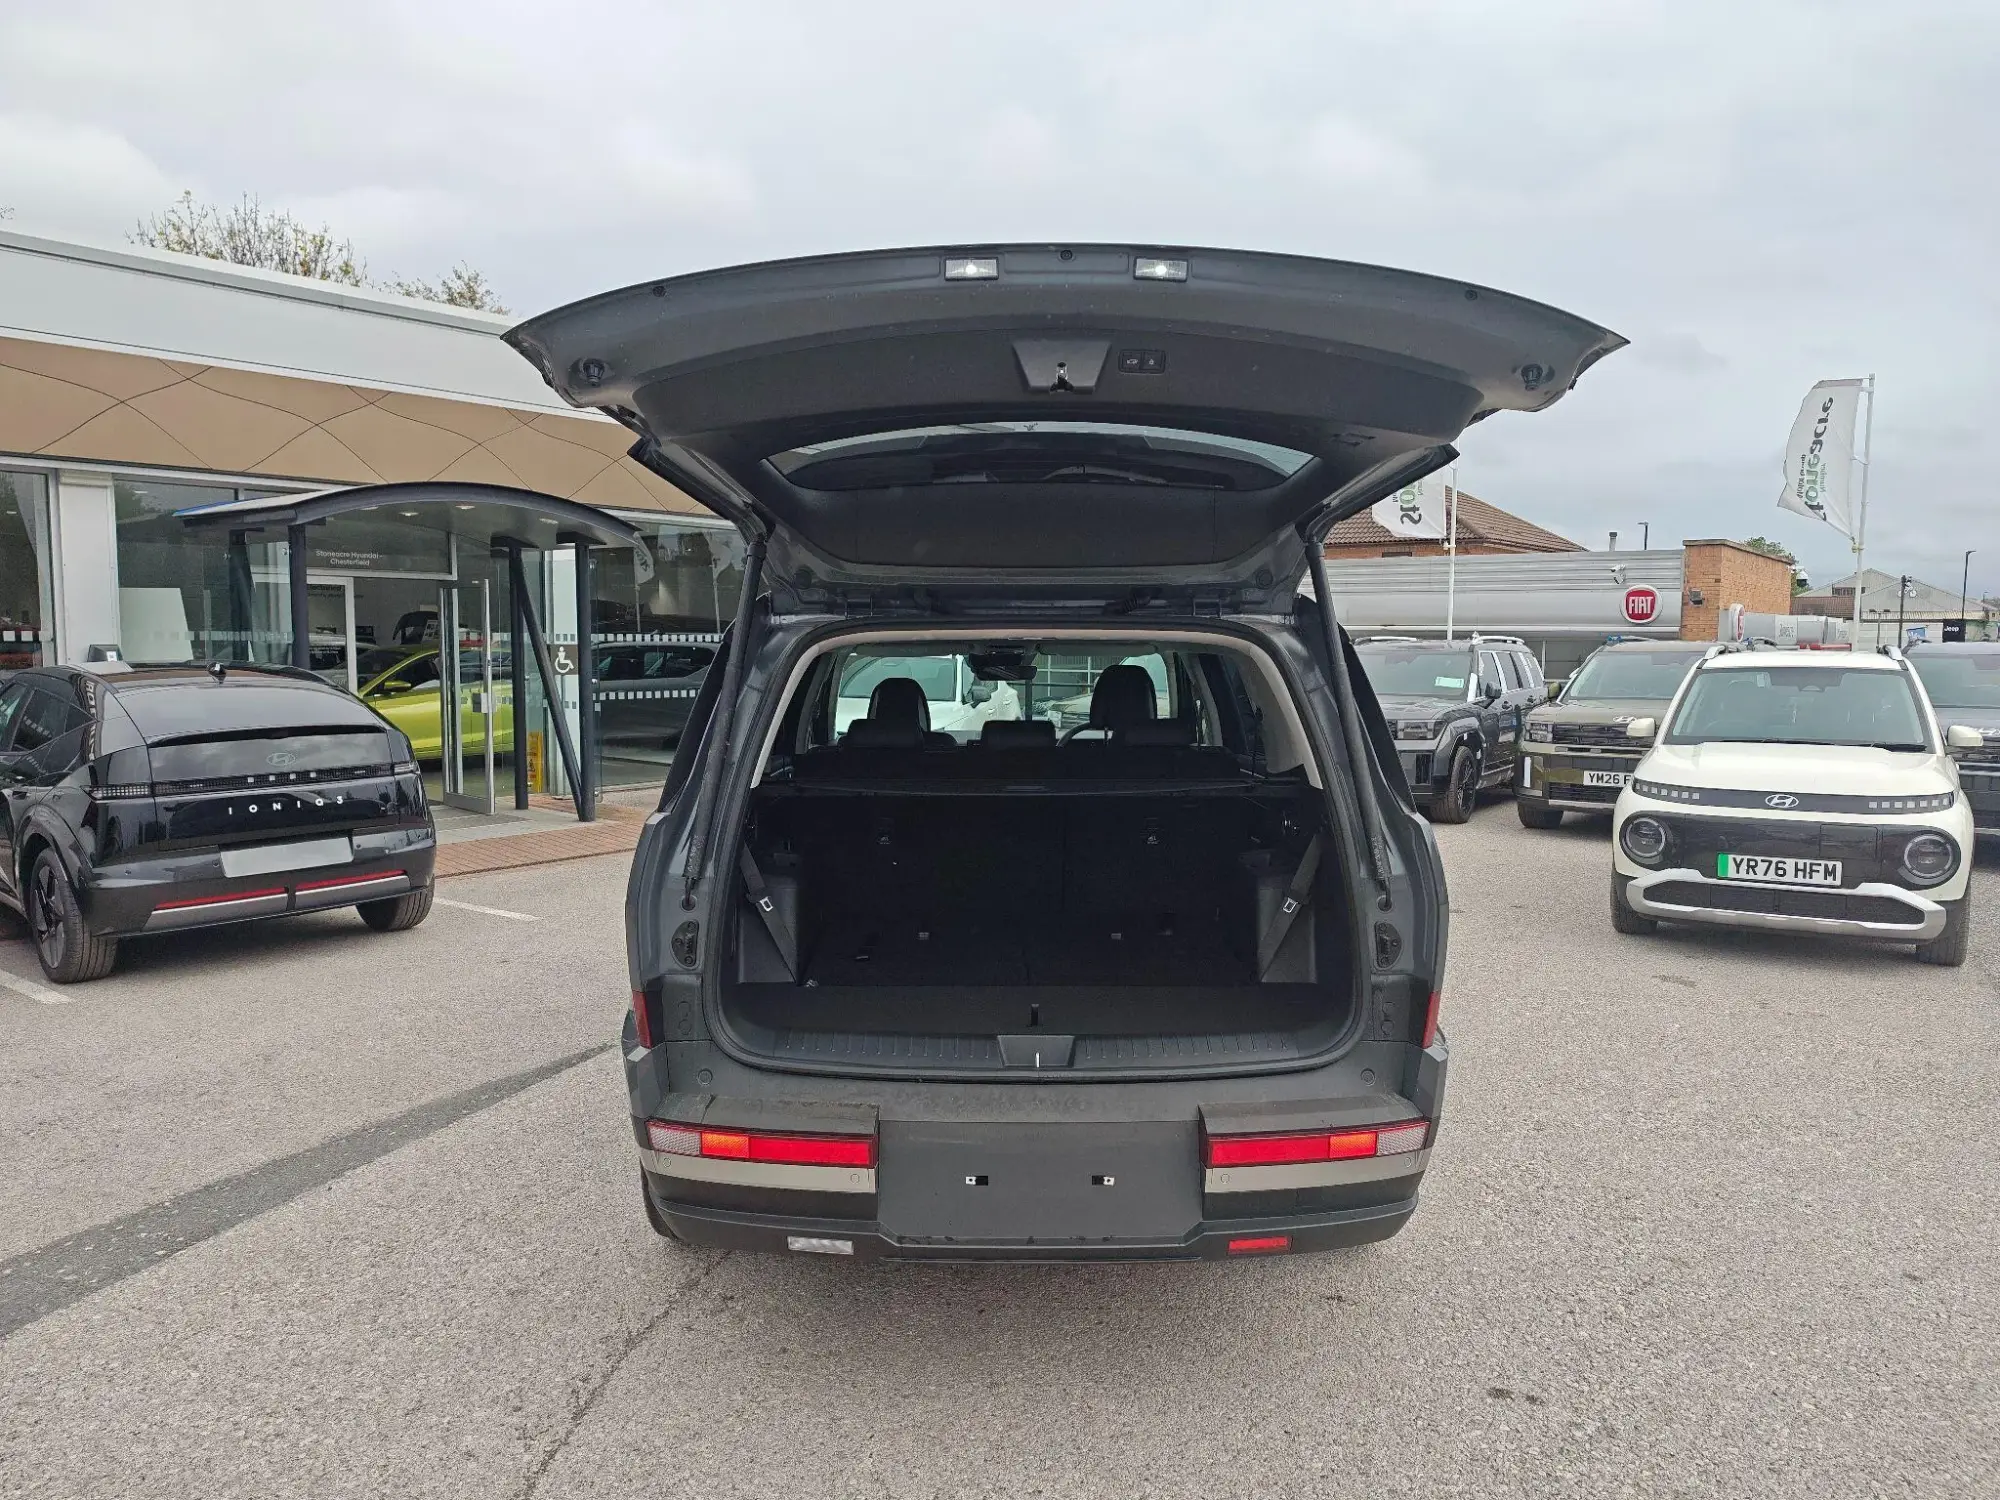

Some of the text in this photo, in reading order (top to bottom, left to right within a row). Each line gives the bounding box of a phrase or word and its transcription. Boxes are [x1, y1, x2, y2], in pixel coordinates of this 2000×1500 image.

[316, 550, 350, 558] Stoneacre
[351, 552, 379, 560] Hyundai
[1628, 596, 1654, 614] FIAT
[1588, 772, 1620, 785] YM26
[1732, 857, 1837, 881] YR76 HFM
